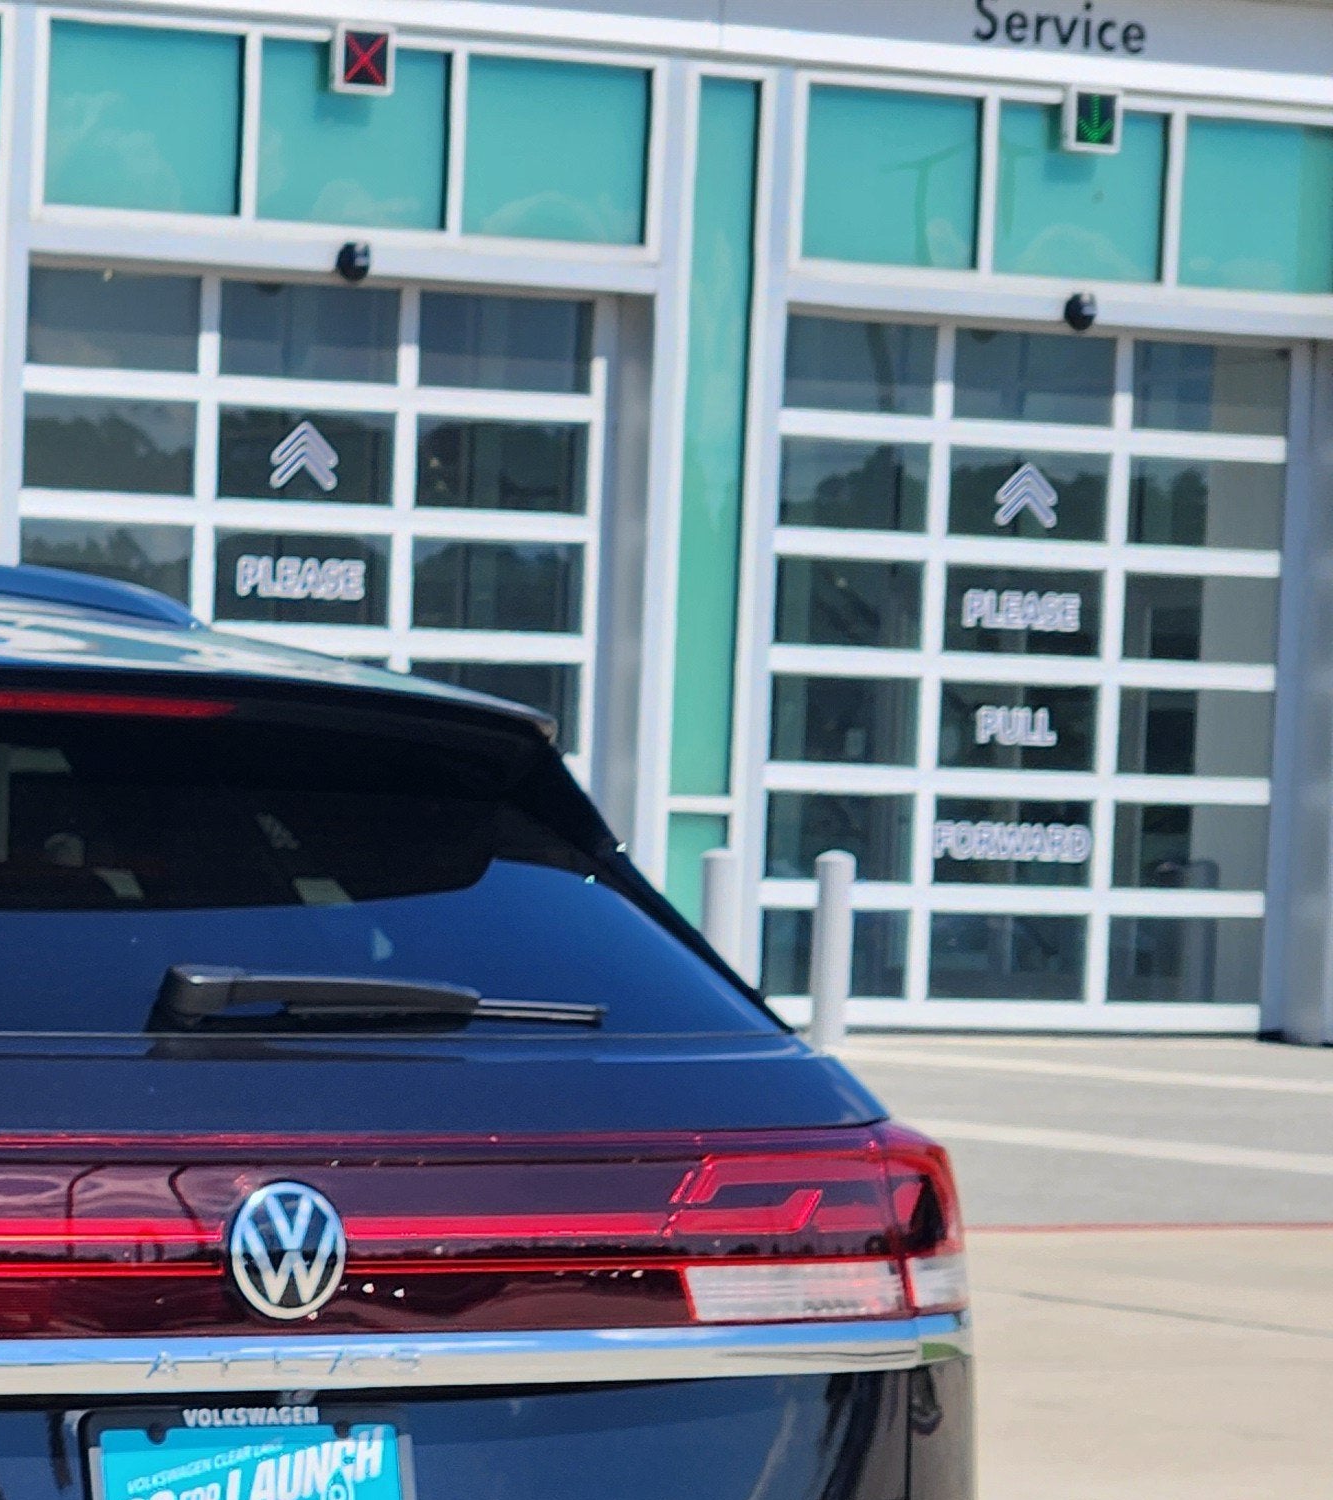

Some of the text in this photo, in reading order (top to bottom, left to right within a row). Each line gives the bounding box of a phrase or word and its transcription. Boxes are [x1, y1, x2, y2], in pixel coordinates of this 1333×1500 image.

[974, 0, 1146, 54] Service
[236, 555, 366, 601] PLEASE
[962, 588, 1081, 633] PLEASE
[975, 705, 1057, 748] PULL
[933, 819, 1091, 864] FORWARD
[145, 1348, 422, 1379] ATLAS
[183, 1406, 319, 1427] VOLKSWAGEN
[126, 1458, 212, 1494] VOLKSWAGEN
